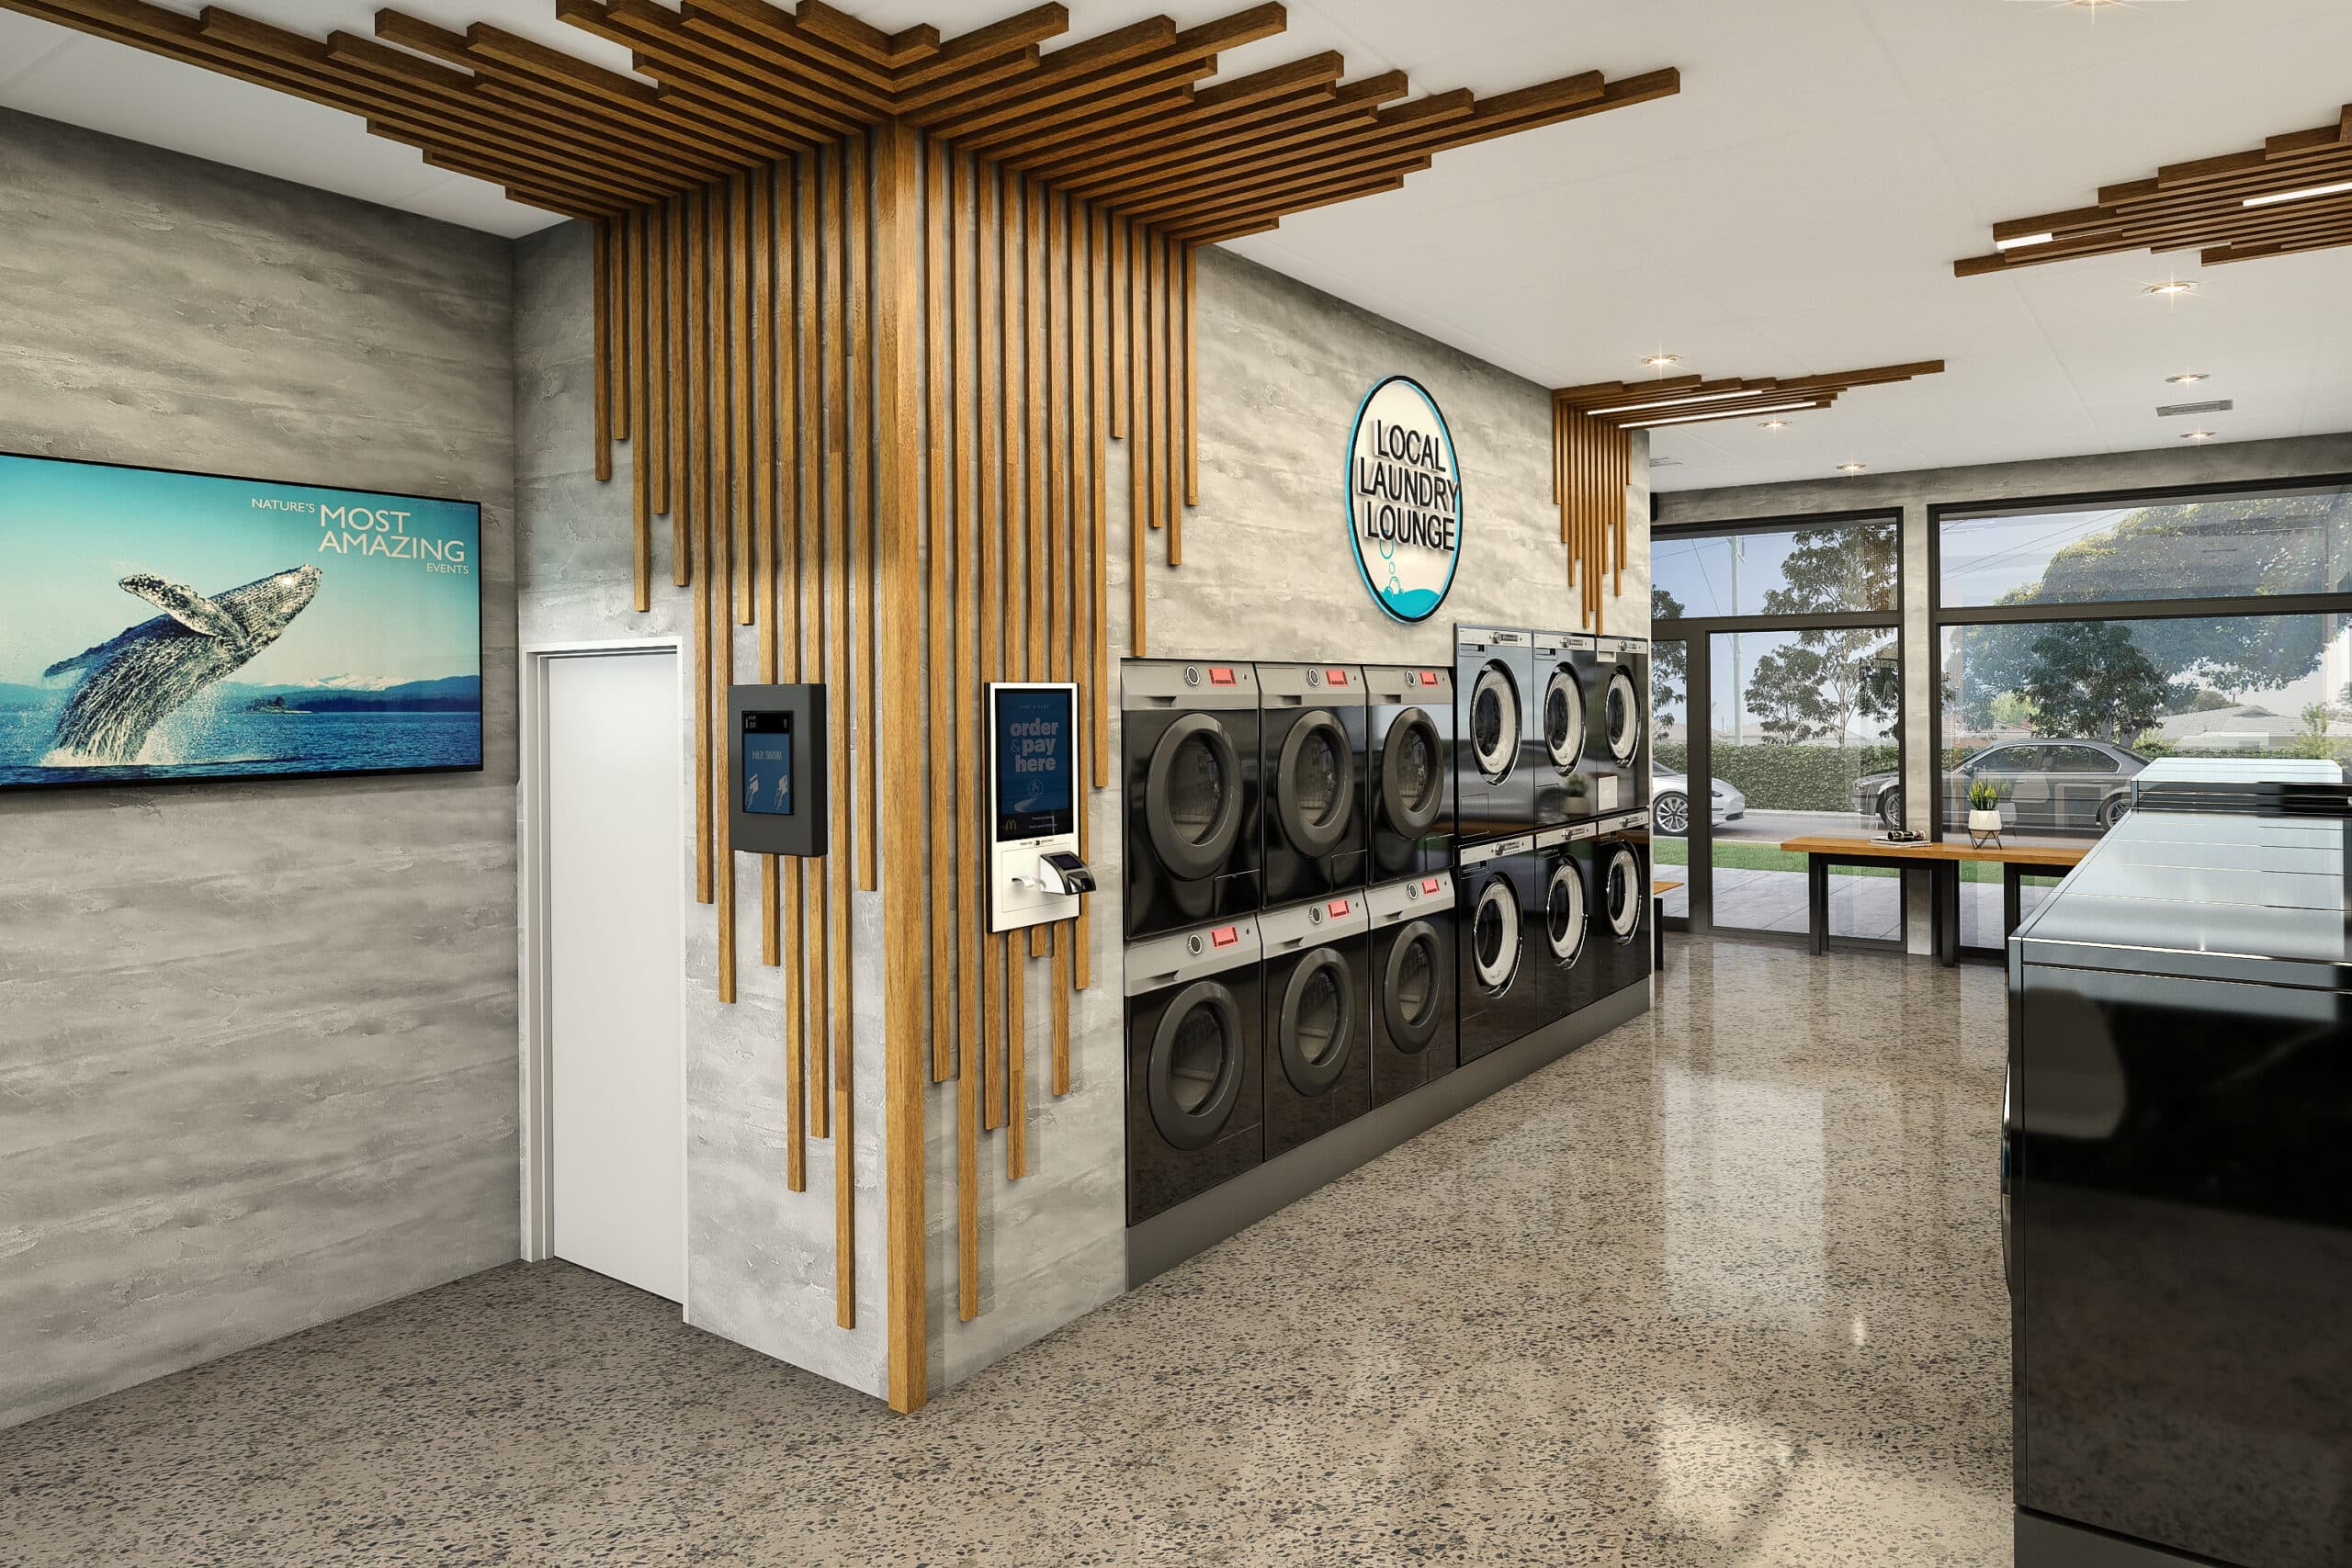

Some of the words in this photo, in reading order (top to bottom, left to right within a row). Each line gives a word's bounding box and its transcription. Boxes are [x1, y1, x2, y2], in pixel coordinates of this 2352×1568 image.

[1375, 419, 1446, 472] LOCAL
[1359, 457, 1460, 513] LAUNDRY
[251, 497, 315, 513] NATURE'S
[320, 503, 412, 534] MOST
[1365, 502, 1455, 552] LOUNGE
[318, 530, 466, 562] AMAZING
[426, 563, 469, 575] EVENTS
[1010, 717, 1058, 737] order
[1023, 738, 1057, 756] pay
[1014, 754, 1057, 773] here
